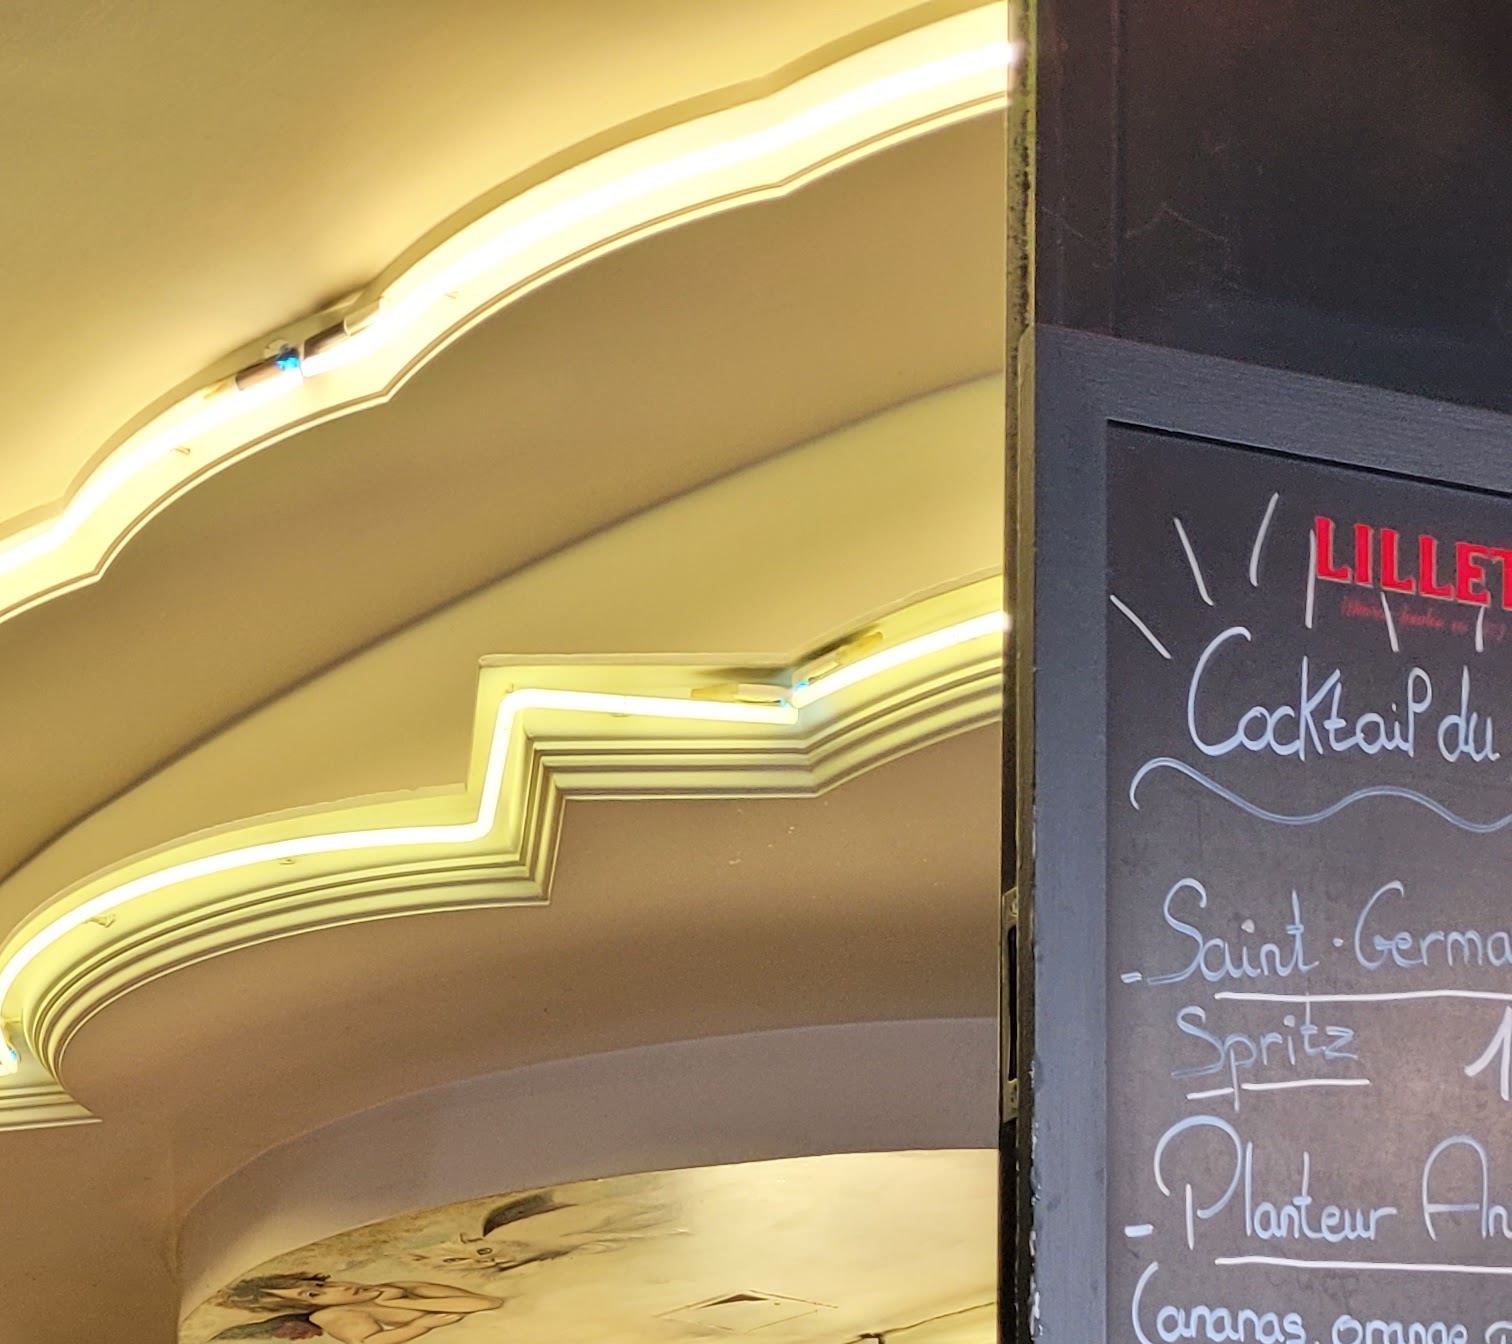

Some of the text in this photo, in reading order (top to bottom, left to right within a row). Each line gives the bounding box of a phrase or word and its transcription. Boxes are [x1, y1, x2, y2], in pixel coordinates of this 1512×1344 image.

[1314, 516, 1512, 611] LILLET
[1188, 626, 1501, 762] Cocktail du
[1147, 877, 1320, 986] Saint
[1171, 991, 1359, 1113] Spritz
[1153, 1114, 1397, 1250] Planteur
